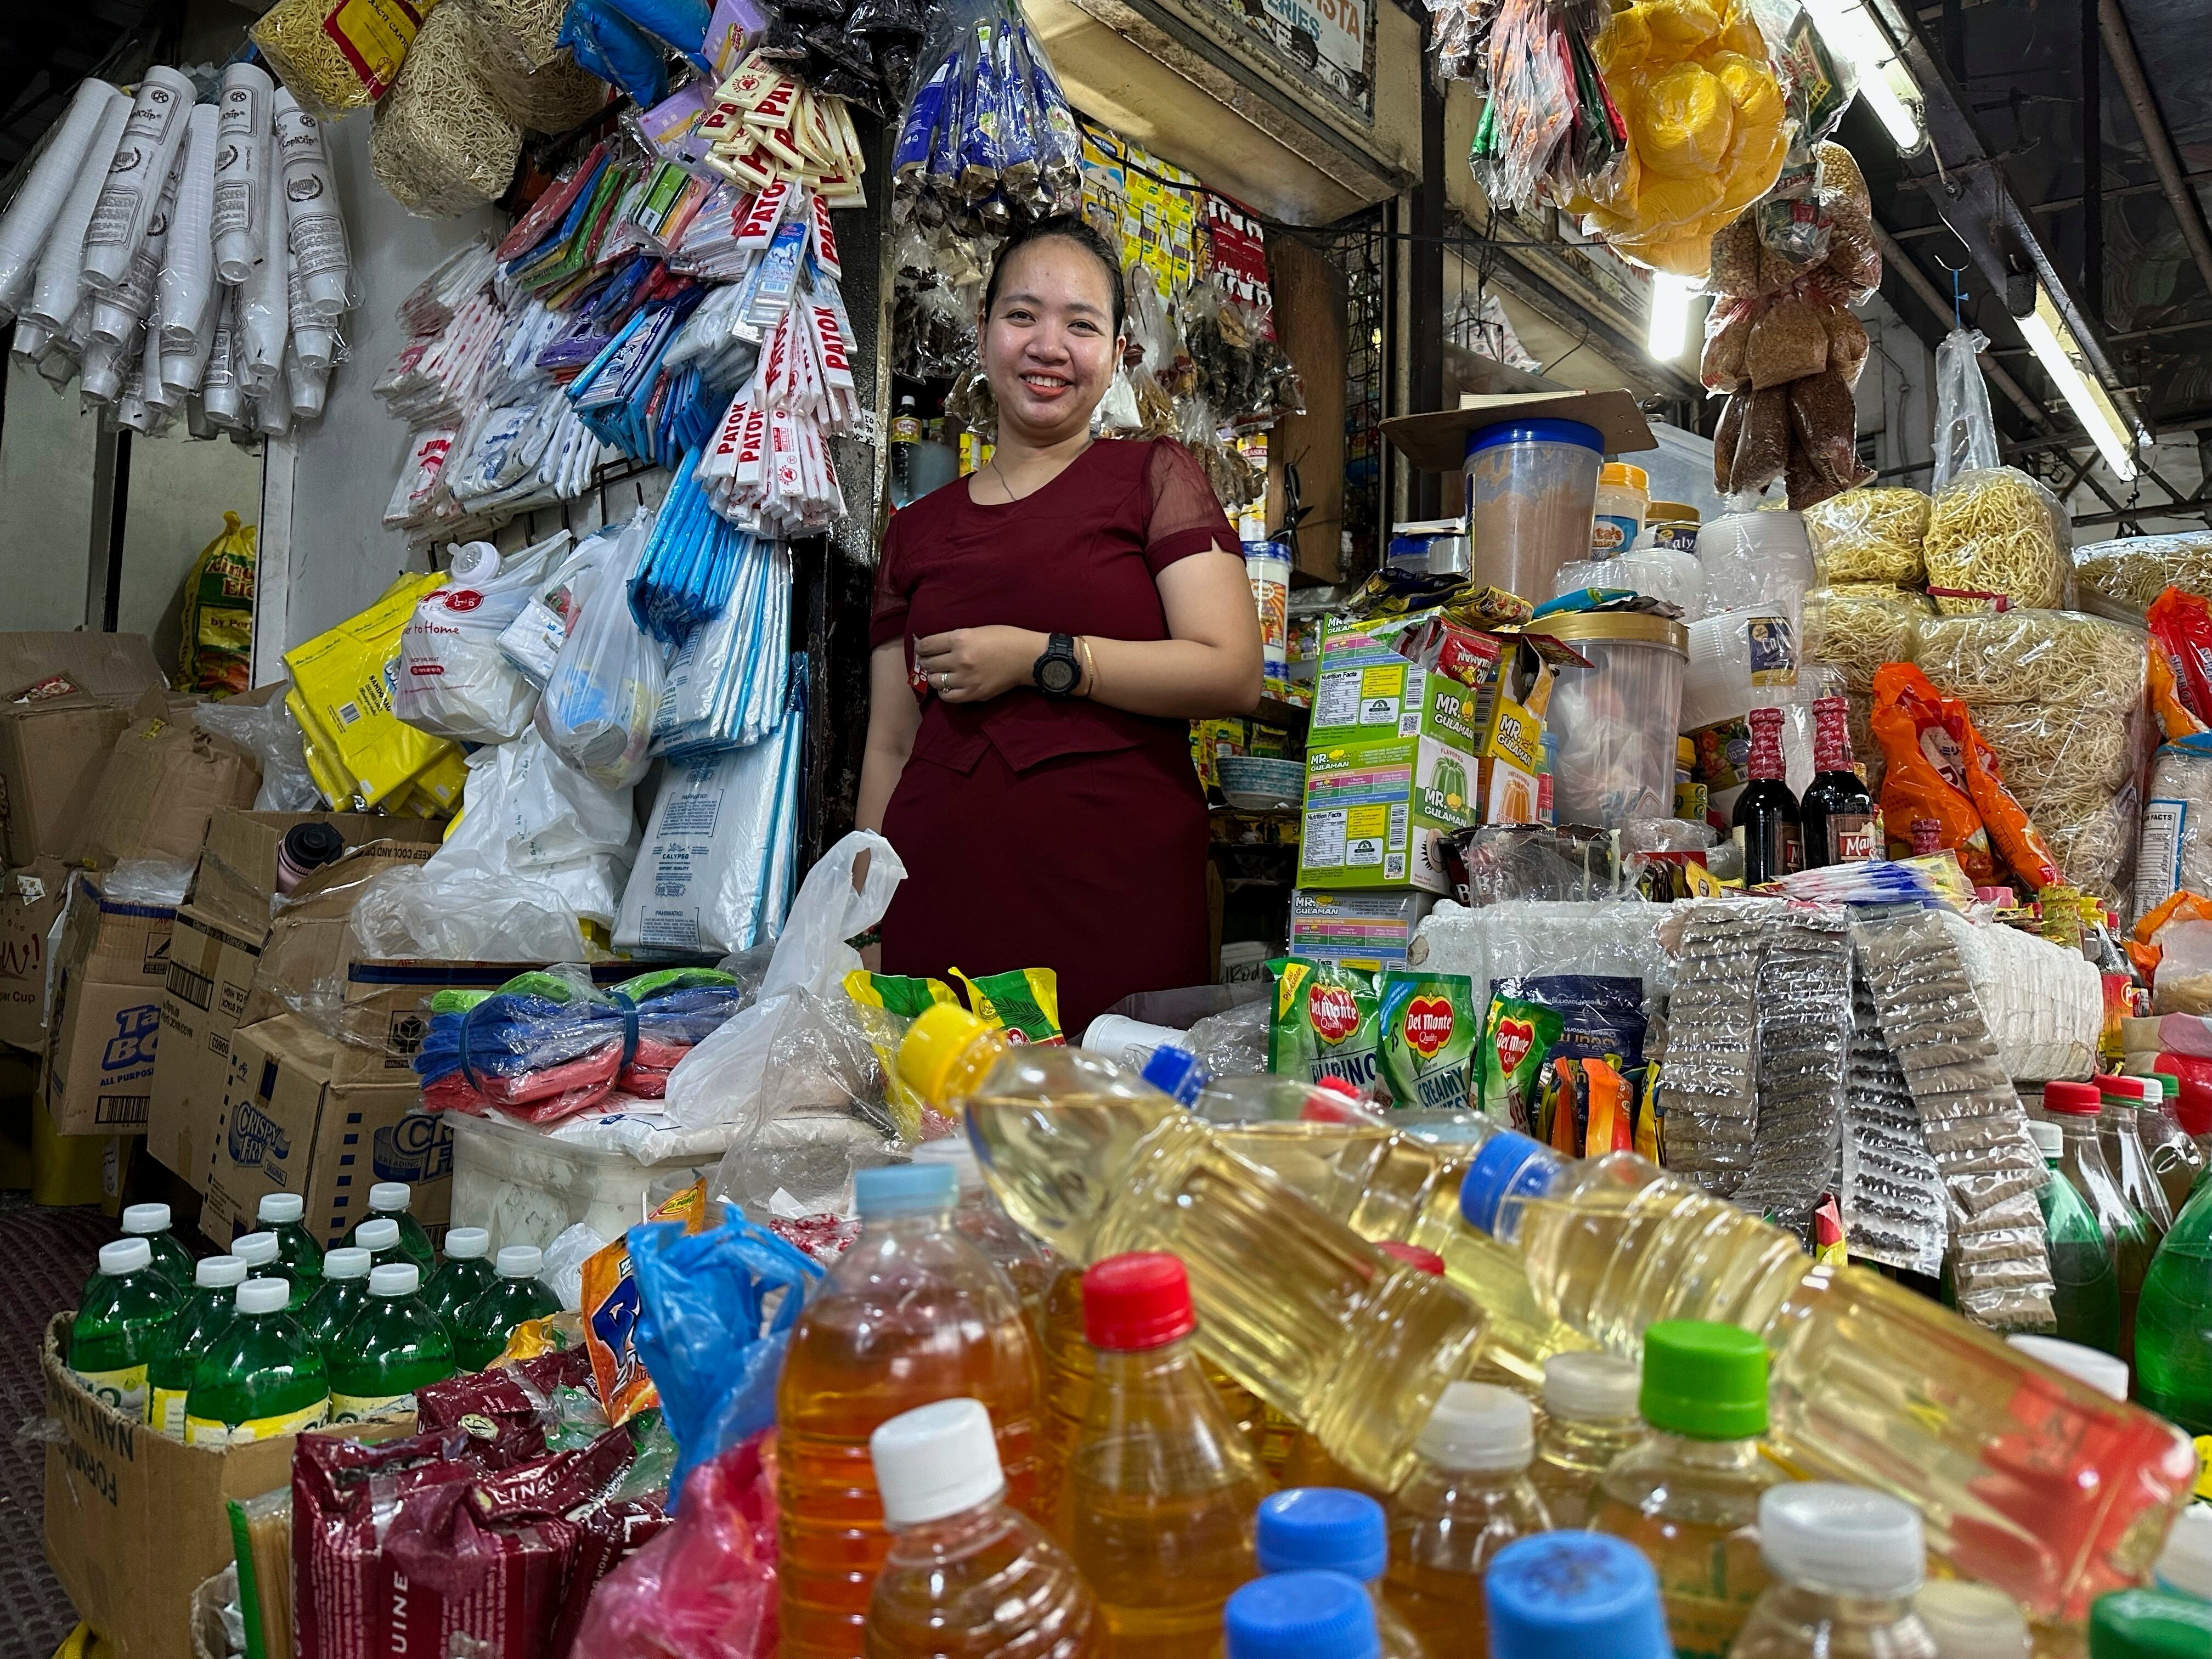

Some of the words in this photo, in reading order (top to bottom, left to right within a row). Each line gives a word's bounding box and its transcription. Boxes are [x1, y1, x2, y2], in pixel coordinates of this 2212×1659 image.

[812, 306, 850, 371] PATOK
[716, 401, 748, 455] PATOK
[739, 409, 764, 462] PATOK
[211, 617, 224, 628] by
[415, 623, 422, 635] to
[425, 620, 460, 635] Home
[368, 675, 387, 699] SANDO
[1435, 692, 1461, 719] MR.
[1434, 713, 1474, 740] GULAMAN
[1499, 714, 1521, 743] MR.
[1311, 753, 1330, 765] MR.
[1440, 747, 1464, 763] FLAVORED
[1497, 736, 1533, 768] GULAMAN
[1728, 751, 1738, 760] 10
[1310, 761, 1350, 772] GULAMAN
[1425, 787, 1447, 810] MR.
[1424, 806, 1467, 828] GULAMAN
[2150, 813, 2172, 822] FACTS
[377, 847, 392, 857] AND
[394, 849, 413, 859] COOL
[413, 850, 431, 860] KEEP
[1295, 896, 1316, 908] MR.
[12, 992, 36, 1003] Cup
[223, 987, 235, 998] HIGH
[221, 998, 236, 1013] STACK
[1311, 997, 1322, 1015] Del
[1322, 995, 1357, 1020] Monte
[1551, 997, 1582, 1007] Flavoring
[1407, 1014, 1420, 1031] Del
[1423, 1014, 1452, 1030] Monte
[211, 1036, 229, 1054] 00603
[1419, 1031, 1438, 1045] Quality
[1497, 1032, 1508, 1049] Del
[100, 1077, 115, 1087] ALL
[1417, 1066, 1466, 1108] CREAMY
[235, 1100, 283, 1144] CRISPY
[241, 1136, 268, 1165] FRY
[266, 1163, 285, 1184] ORIGINAL
